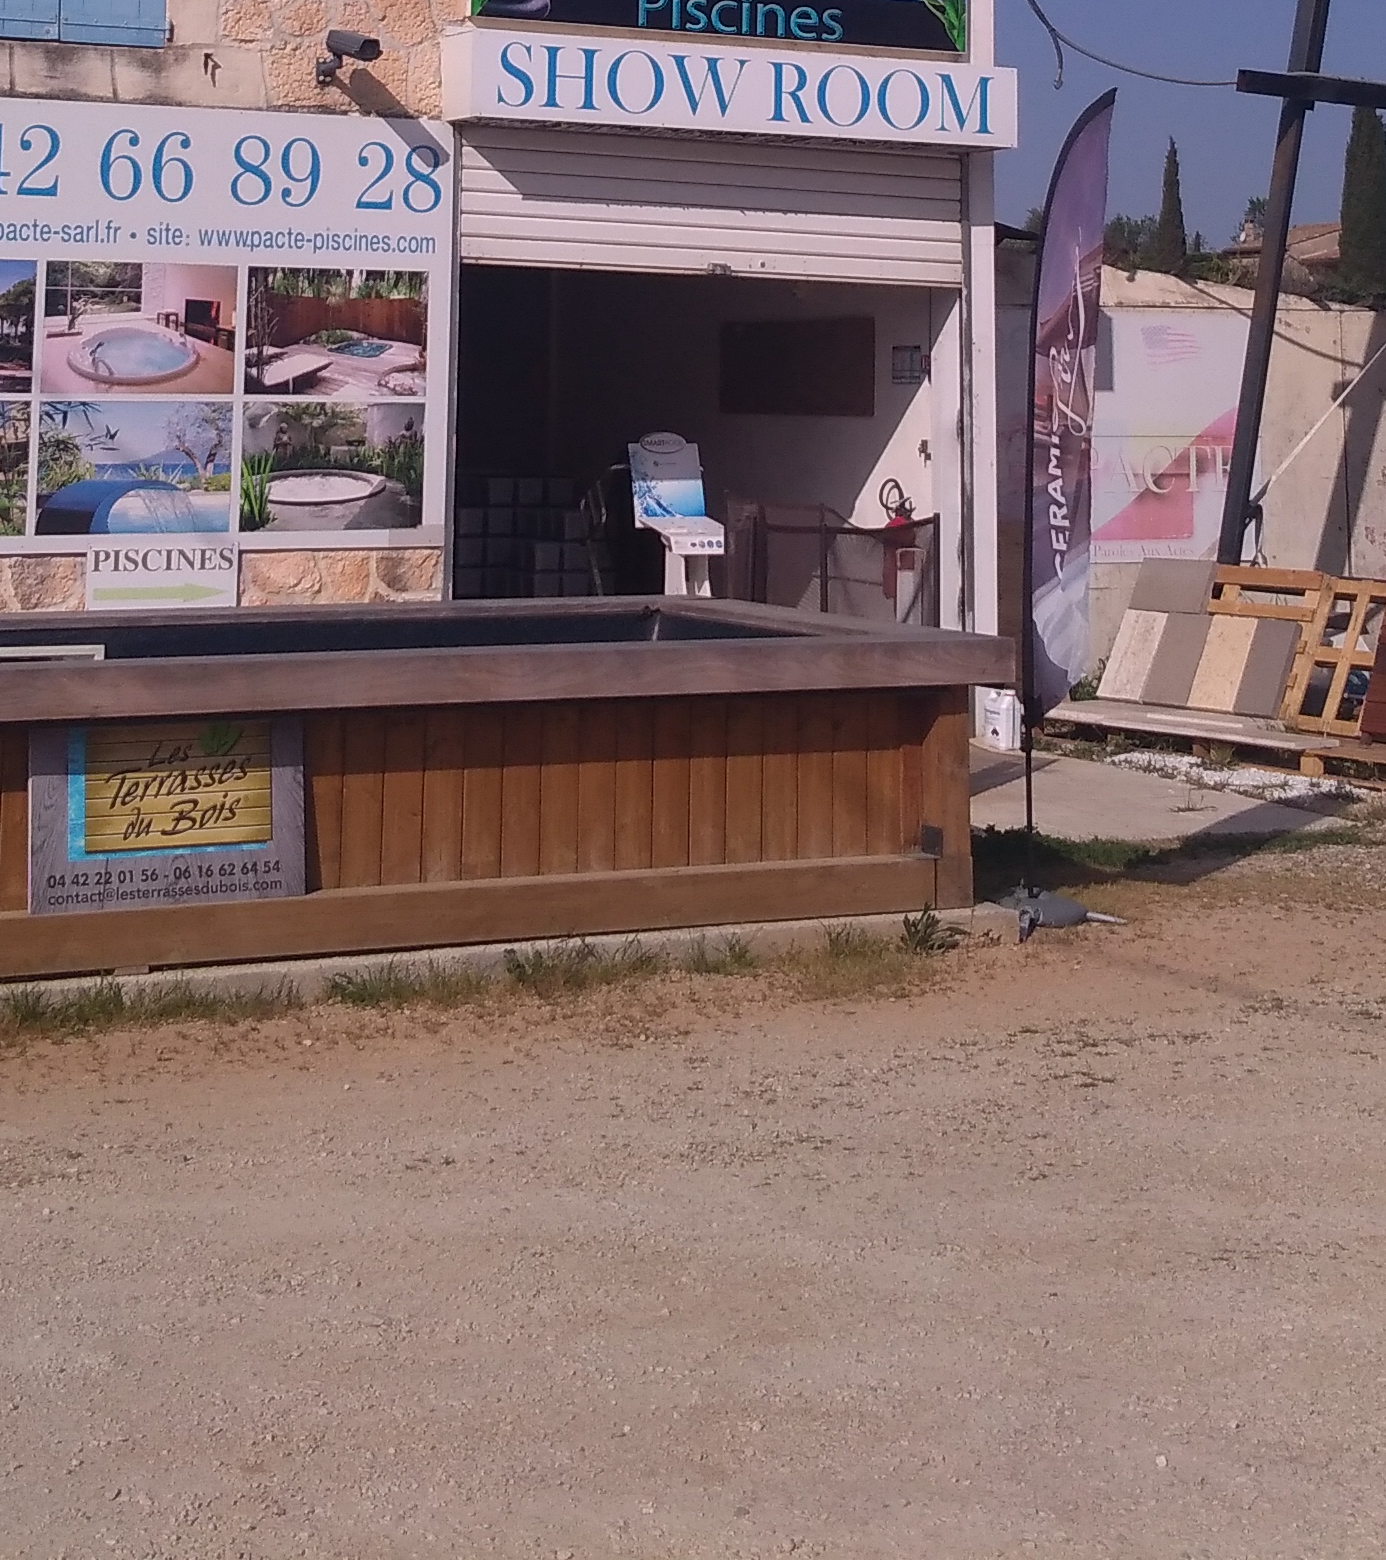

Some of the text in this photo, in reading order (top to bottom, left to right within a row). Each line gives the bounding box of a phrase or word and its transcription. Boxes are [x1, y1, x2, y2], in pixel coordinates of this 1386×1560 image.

[496, 41, 995, 135] SHOW ROOM
[100, 129, 194, 204] 66
[230, 135, 321, 207] 89
[355, 141, 442, 214] 28
[147, 221, 191, 247] site:
[91, 547, 234, 572] PISCINES
[148, 741, 192, 768] Les
[105, 756, 251, 810] Terrasses
[123, 792, 242, 841] du Bois
[47, 875, 66, 888] 04
[71, 872, 89, 887] 42
[94, 871, 112, 885] 22
[118, 870, 134, 884] 01
[141, 868, 158, 882] 56
[173, 865, 191, 880] 06
[198, 864, 213, 878] 16
[219, 862, 236, 876] 62
[241, 861, 258, 876] 64
[263, 860, 281, 874] 54
[48, 878, 282, 906] contact@lesterrassesdubois.com
